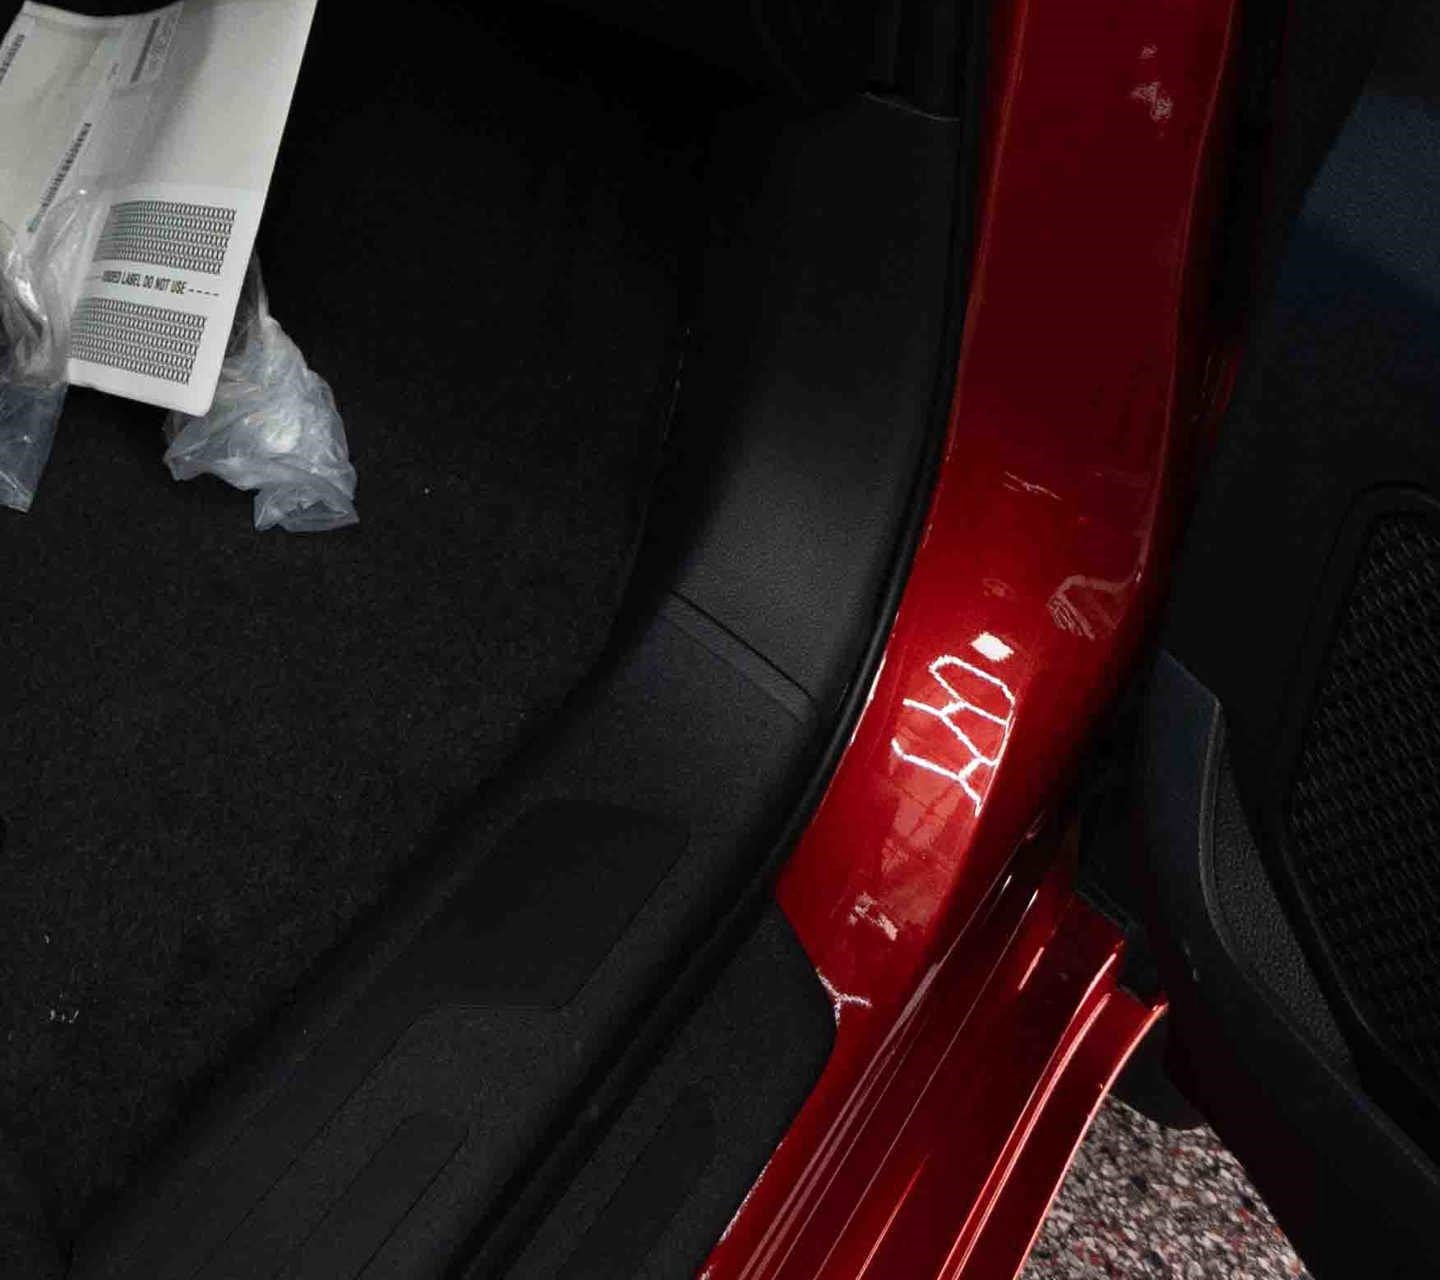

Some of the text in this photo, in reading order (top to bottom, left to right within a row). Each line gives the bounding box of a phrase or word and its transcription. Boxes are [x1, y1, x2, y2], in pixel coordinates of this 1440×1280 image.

[121, 271, 142, 288] LABEL
[142, 274, 155, 289] DO
[154, 277, 172, 291] NOT
[170, 279, 188, 295] USE
